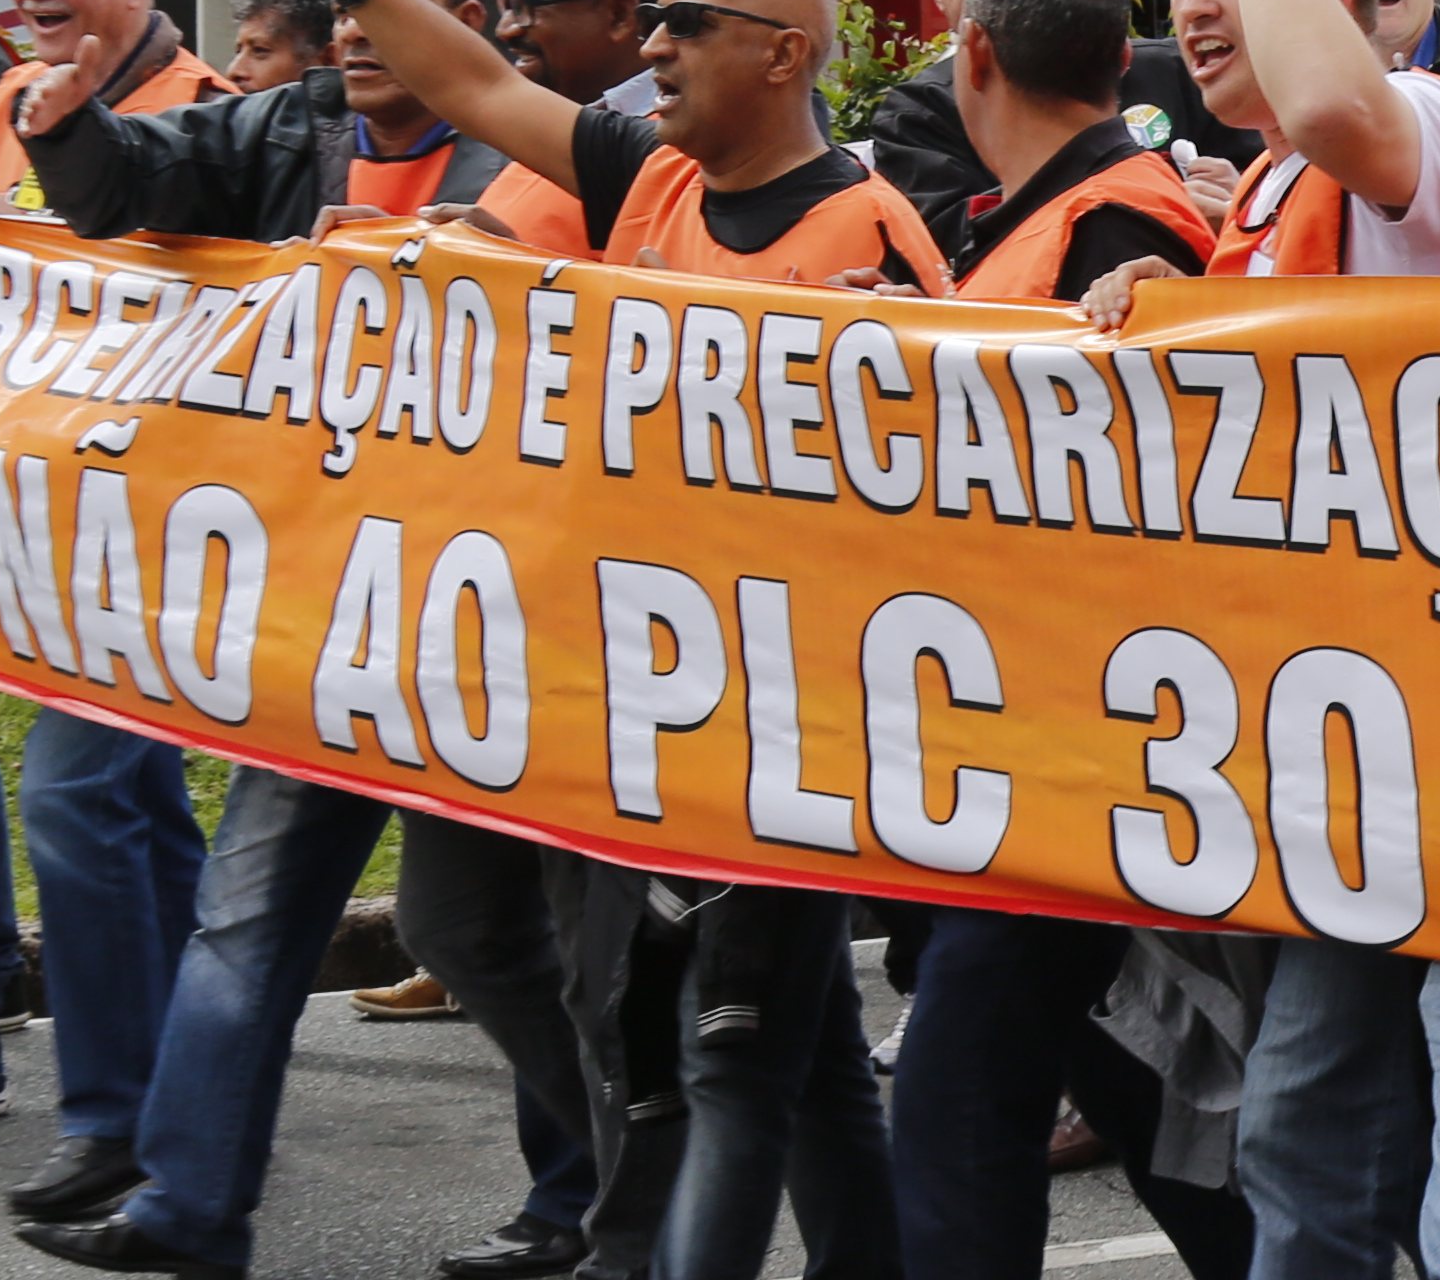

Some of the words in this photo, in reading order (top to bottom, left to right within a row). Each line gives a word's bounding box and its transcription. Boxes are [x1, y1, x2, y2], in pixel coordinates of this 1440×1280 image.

[519, 259, 577, 466] É
[312, 515, 531, 792] AO
[597, 557, 1013, 874] PLC
[1103, 625, 1427, 948] 30
